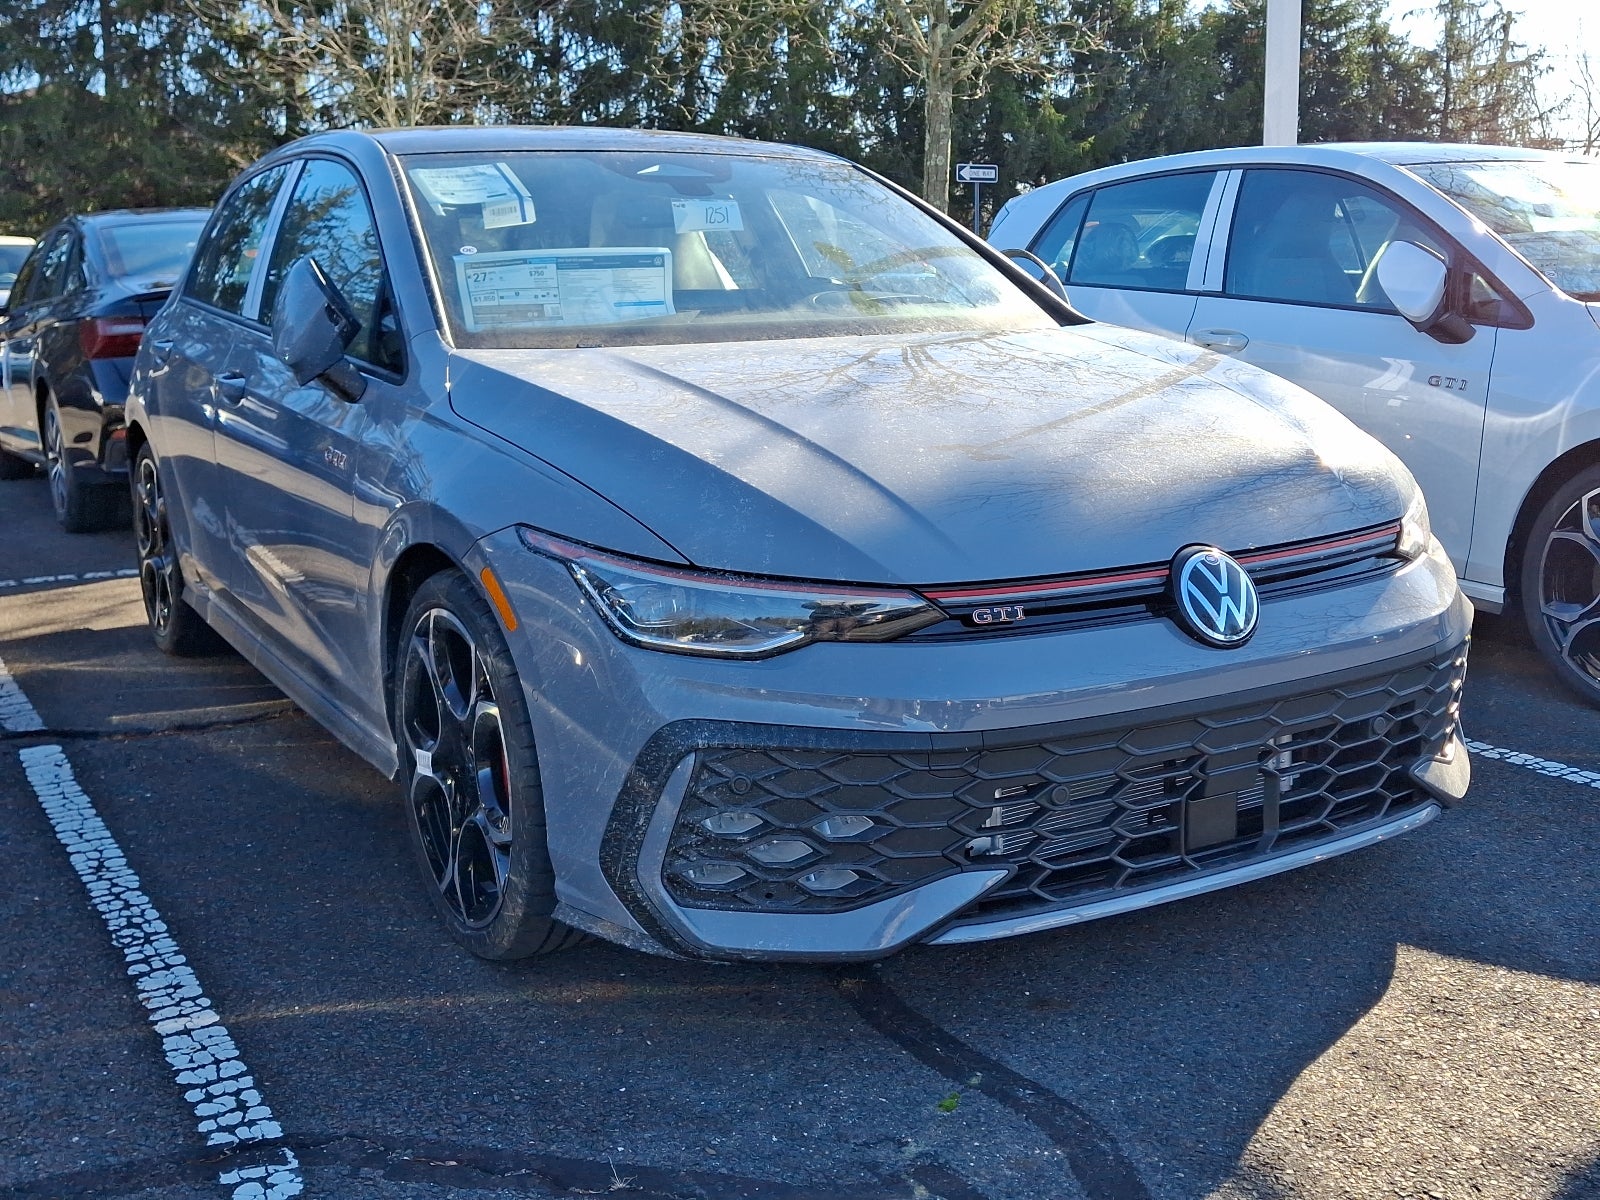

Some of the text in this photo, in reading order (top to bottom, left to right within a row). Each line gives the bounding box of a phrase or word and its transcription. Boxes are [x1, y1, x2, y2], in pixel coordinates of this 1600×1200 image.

[472, 272, 487, 283] 27
[1428, 375, 1467, 391] GTI
[972, 605, 1026, 624] GTI
